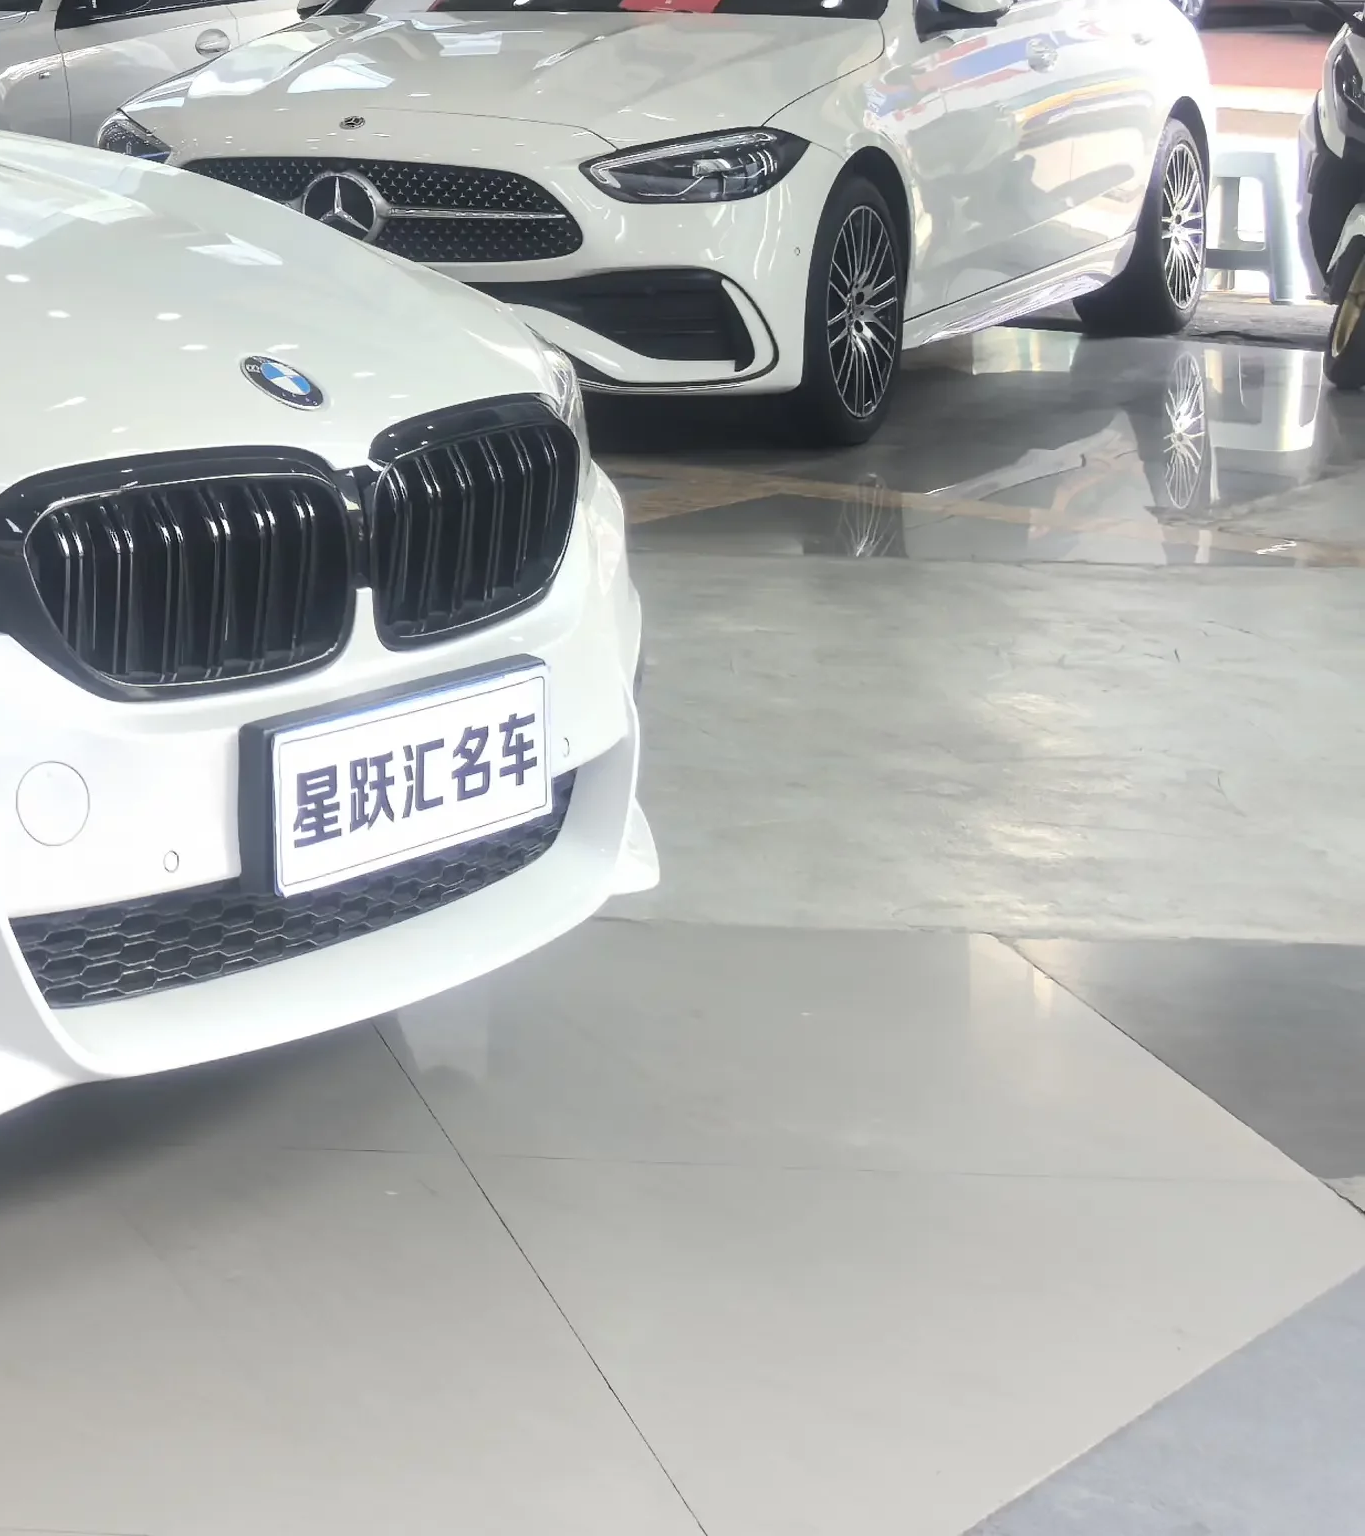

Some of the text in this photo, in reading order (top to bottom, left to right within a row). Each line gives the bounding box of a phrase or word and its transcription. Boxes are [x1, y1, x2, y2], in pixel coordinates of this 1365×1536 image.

[293, 712, 538, 848] 星跃汇名车
